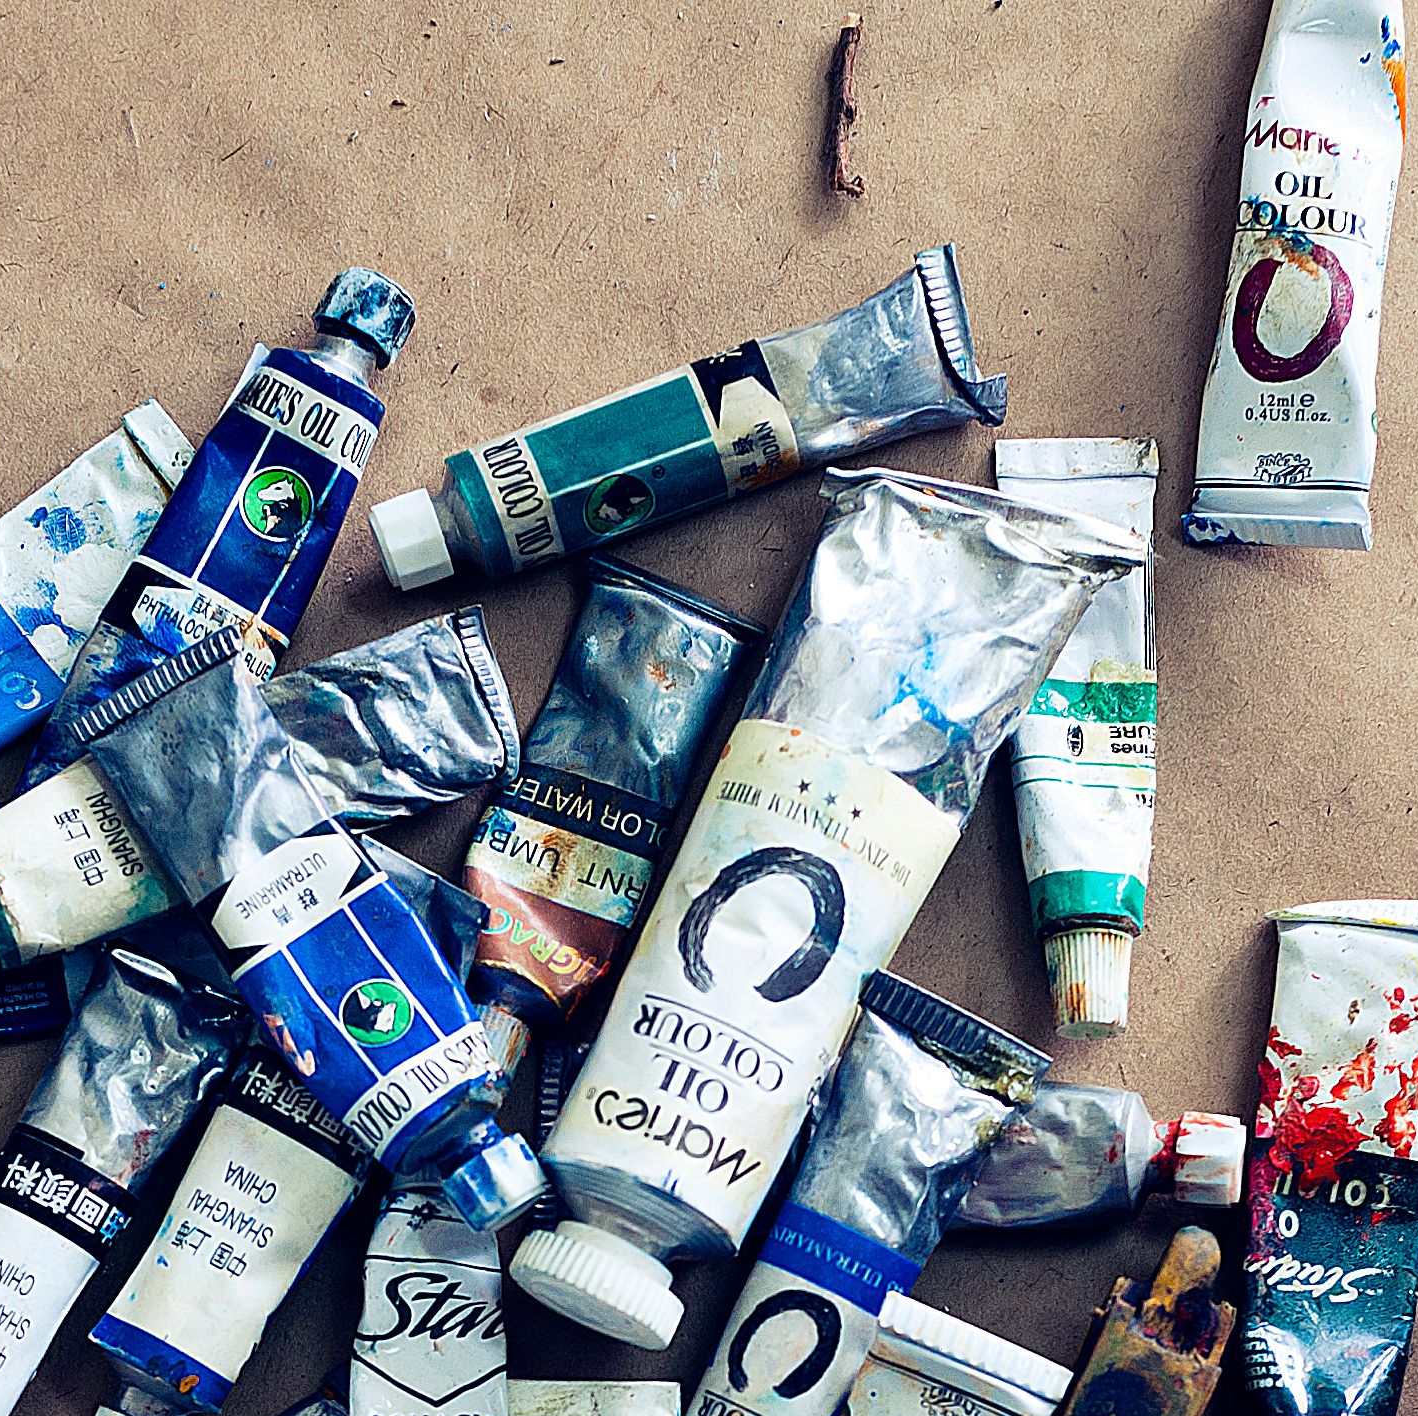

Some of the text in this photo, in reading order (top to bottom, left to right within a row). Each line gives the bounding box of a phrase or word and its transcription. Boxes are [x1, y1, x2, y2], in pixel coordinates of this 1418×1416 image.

[1275, 172, 1332, 199] OIL
[1235, 201, 1356, 234] COLOUR
[1246, 408, 1290, 421] 0.4US
[1260, 393, 1294, 411] 12ml
[301, 403, 340, 448] OIL
[483, 438, 543, 519] COLOUR
[515, 516, 554, 555] OIL
[720, 781, 761, 806] WHITE
[54, 809, 107, 886] 中国 上海
[86, 789, 146, 876] SHANGHAI
[859, 841, 889, 868] ZINC
[236, 853, 326, 919] ULTRAMARINE
[891, 862, 911, 887] 106
[633, 1004, 783, 1091] COLOUR
[405, 1061, 448, 1088] OIL
[649, 1054, 732, 1115] OIL
[595, 1090, 760, 1186] Marie's
[225, 1161, 276, 1204] CHINA
[187, 1189, 273, 1248] SHANGHAI
[171, 1221, 247, 1276] 中国 上海
